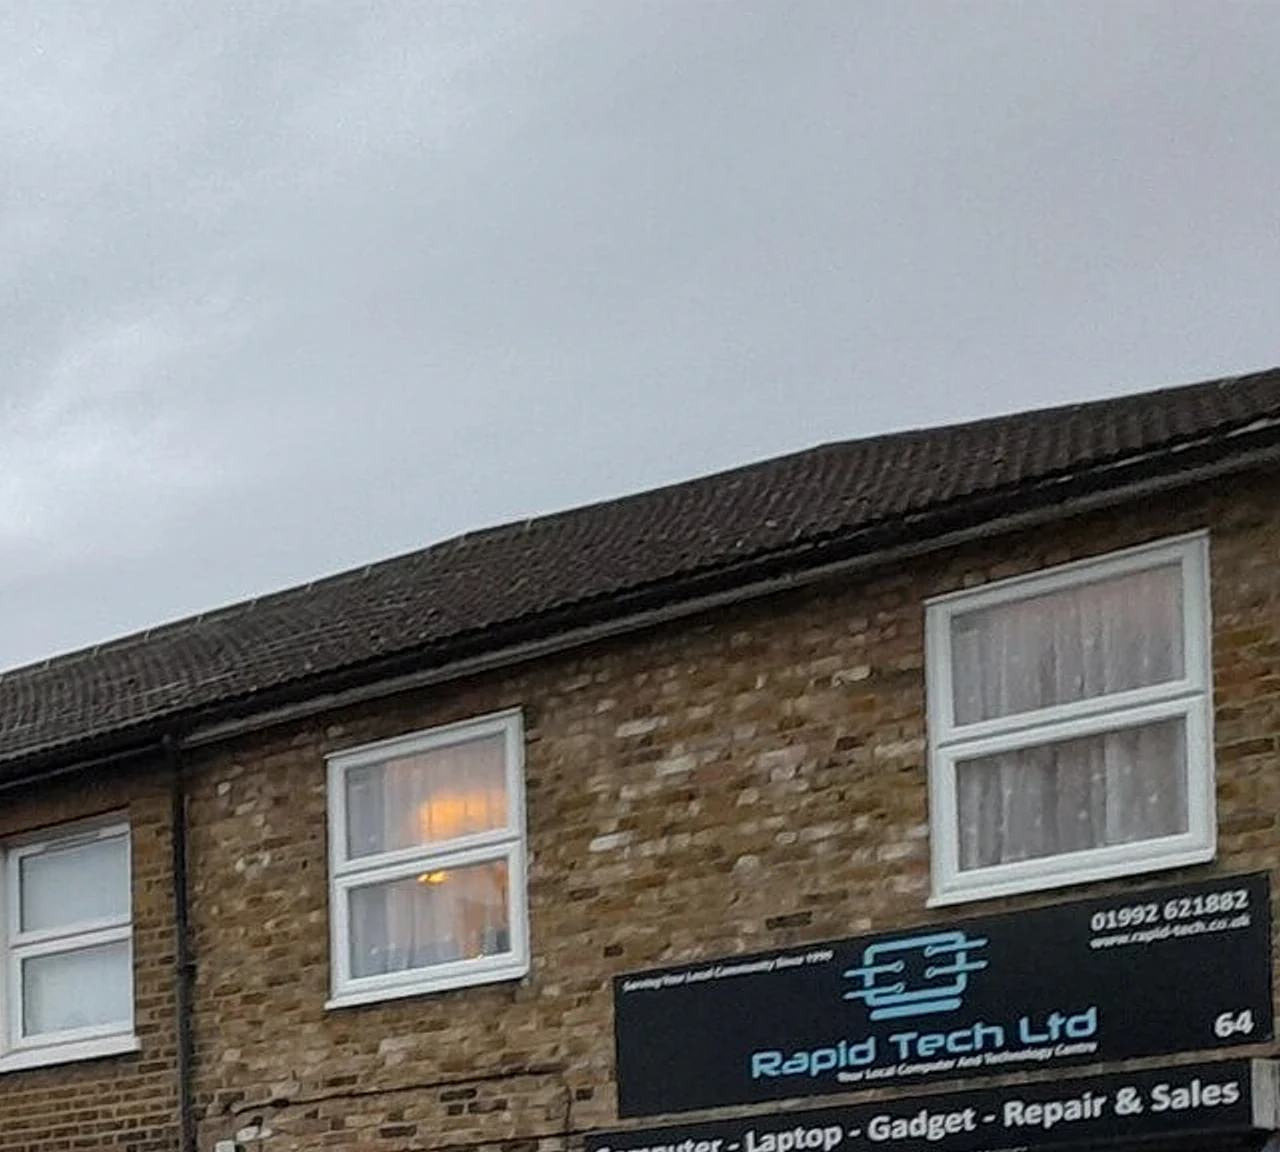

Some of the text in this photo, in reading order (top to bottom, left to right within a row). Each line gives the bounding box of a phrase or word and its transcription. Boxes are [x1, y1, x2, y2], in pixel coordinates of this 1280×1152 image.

[1091, 889, 1250, 931] 01992 621882
[1090, 914, 1251, 949] www.rapid-tech.co.uk
[752, 1006, 1097, 1078] Rapid Tech Ltd
[1214, 1010, 1255, 1038] 64
[866, 1064, 896, 1079] Local
[897, 1057, 955, 1076] Computer
[984, 1046, 1054, 1066] Technology
[867, 1107, 977, 1141] Gadget
[1003, 1092, 1107, 1128] Repair
[1114, 1086, 1143, 1115] &
[1151, 1079, 1240, 1111] Sales
